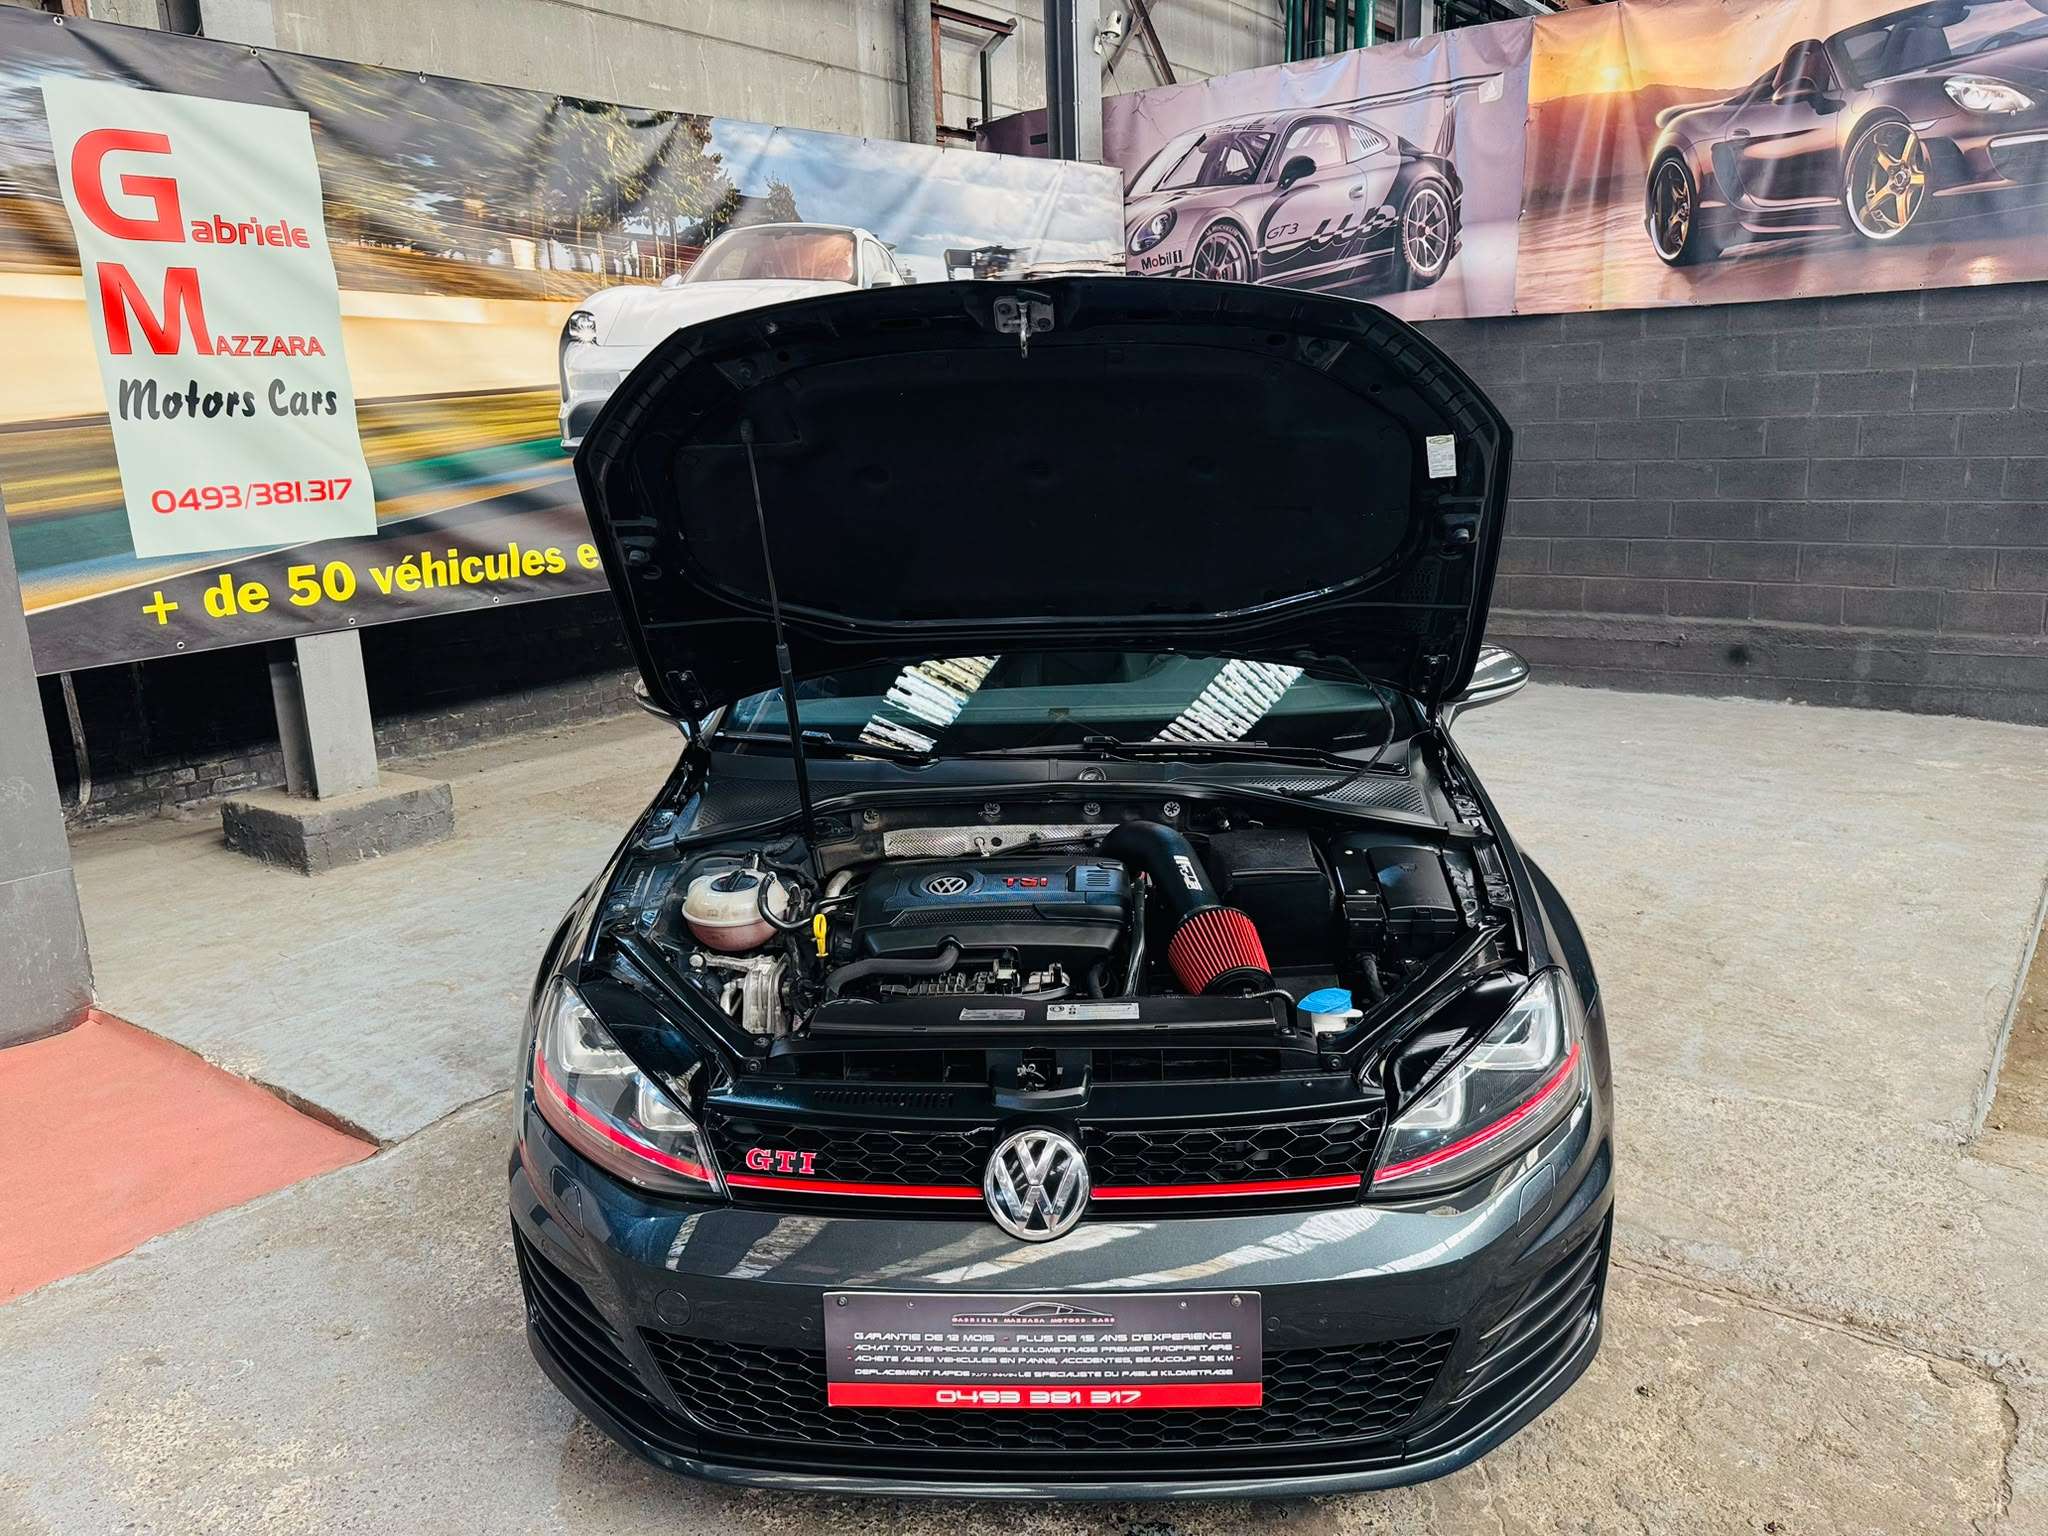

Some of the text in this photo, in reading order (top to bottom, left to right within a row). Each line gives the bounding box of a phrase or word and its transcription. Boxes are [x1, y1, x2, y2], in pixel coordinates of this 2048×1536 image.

[71, 128, 311, 249] Gabriele
[1141, 252, 1172, 270] Mobil
[96, 261, 326, 356] MAZZARA
[118, 378, 338, 421] Motors Cars
[151, 478, 353, 514] 0493/381.317
[203, 574, 270, 618] de
[287, 560, 357, 606] 50
[368, 542, 566, 594] véhicules
[745, 1147, 818, 1175] GTI
[853, 1331, 922, 1342] GARANTIE
[924, 1333, 944, 1342] DE
[946, 1333, 960, 1342] 12
[962, 1333, 996, 1342] MOIS
[1015, 1334, 1054, 1343] PLUS
[1057, 1334, 1077, 1343] DE
[1080, 1334, 1096, 1343] 15
[1099, 1334, 1128, 1343] ANS
[1131, 1331, 1232, 1342] D'EXPERIENCE
[854, 1344, 890, 1352] ACHAT
[893, 1344, 923, 1352] TOUT
[926, 1345, 979, 1353] VEHICULE
[1021, 1345, 1099, 1354] KILOMETRAGE
[1101, 1345, 1150, 1353] PREMIER
[1152, 1343, 1233, 1352] PROPRIETAIRE
[854, 1355, 899, 1363] ACHETE
[901, 1355, 934, 1363] AUSSI
[937, 1356, 998, 1364] VEHICULES
[1135, 1356, 1197, 1364] BEAUCOUP
[1199, 1355, 1215, 1363] DE
[1217, 1355, 1234, 1363] KM
[854, 1368, 931, 1377] DEPLACEMENT
[932, 1370, 971, 1378] RAPIDE
[1018, 1370, 1031, 1378] LE
[1033, 1370, 1102, 1378] SPECIALISTE
[1104, 1370, 1120, 1378] DU
[1122, 1369, 1159, 1378] FAIBLE
[1160, 1368, 1234, 1377] KILOMETRAGE
[936, 1390, 1143, 1405] 0493 381 317
